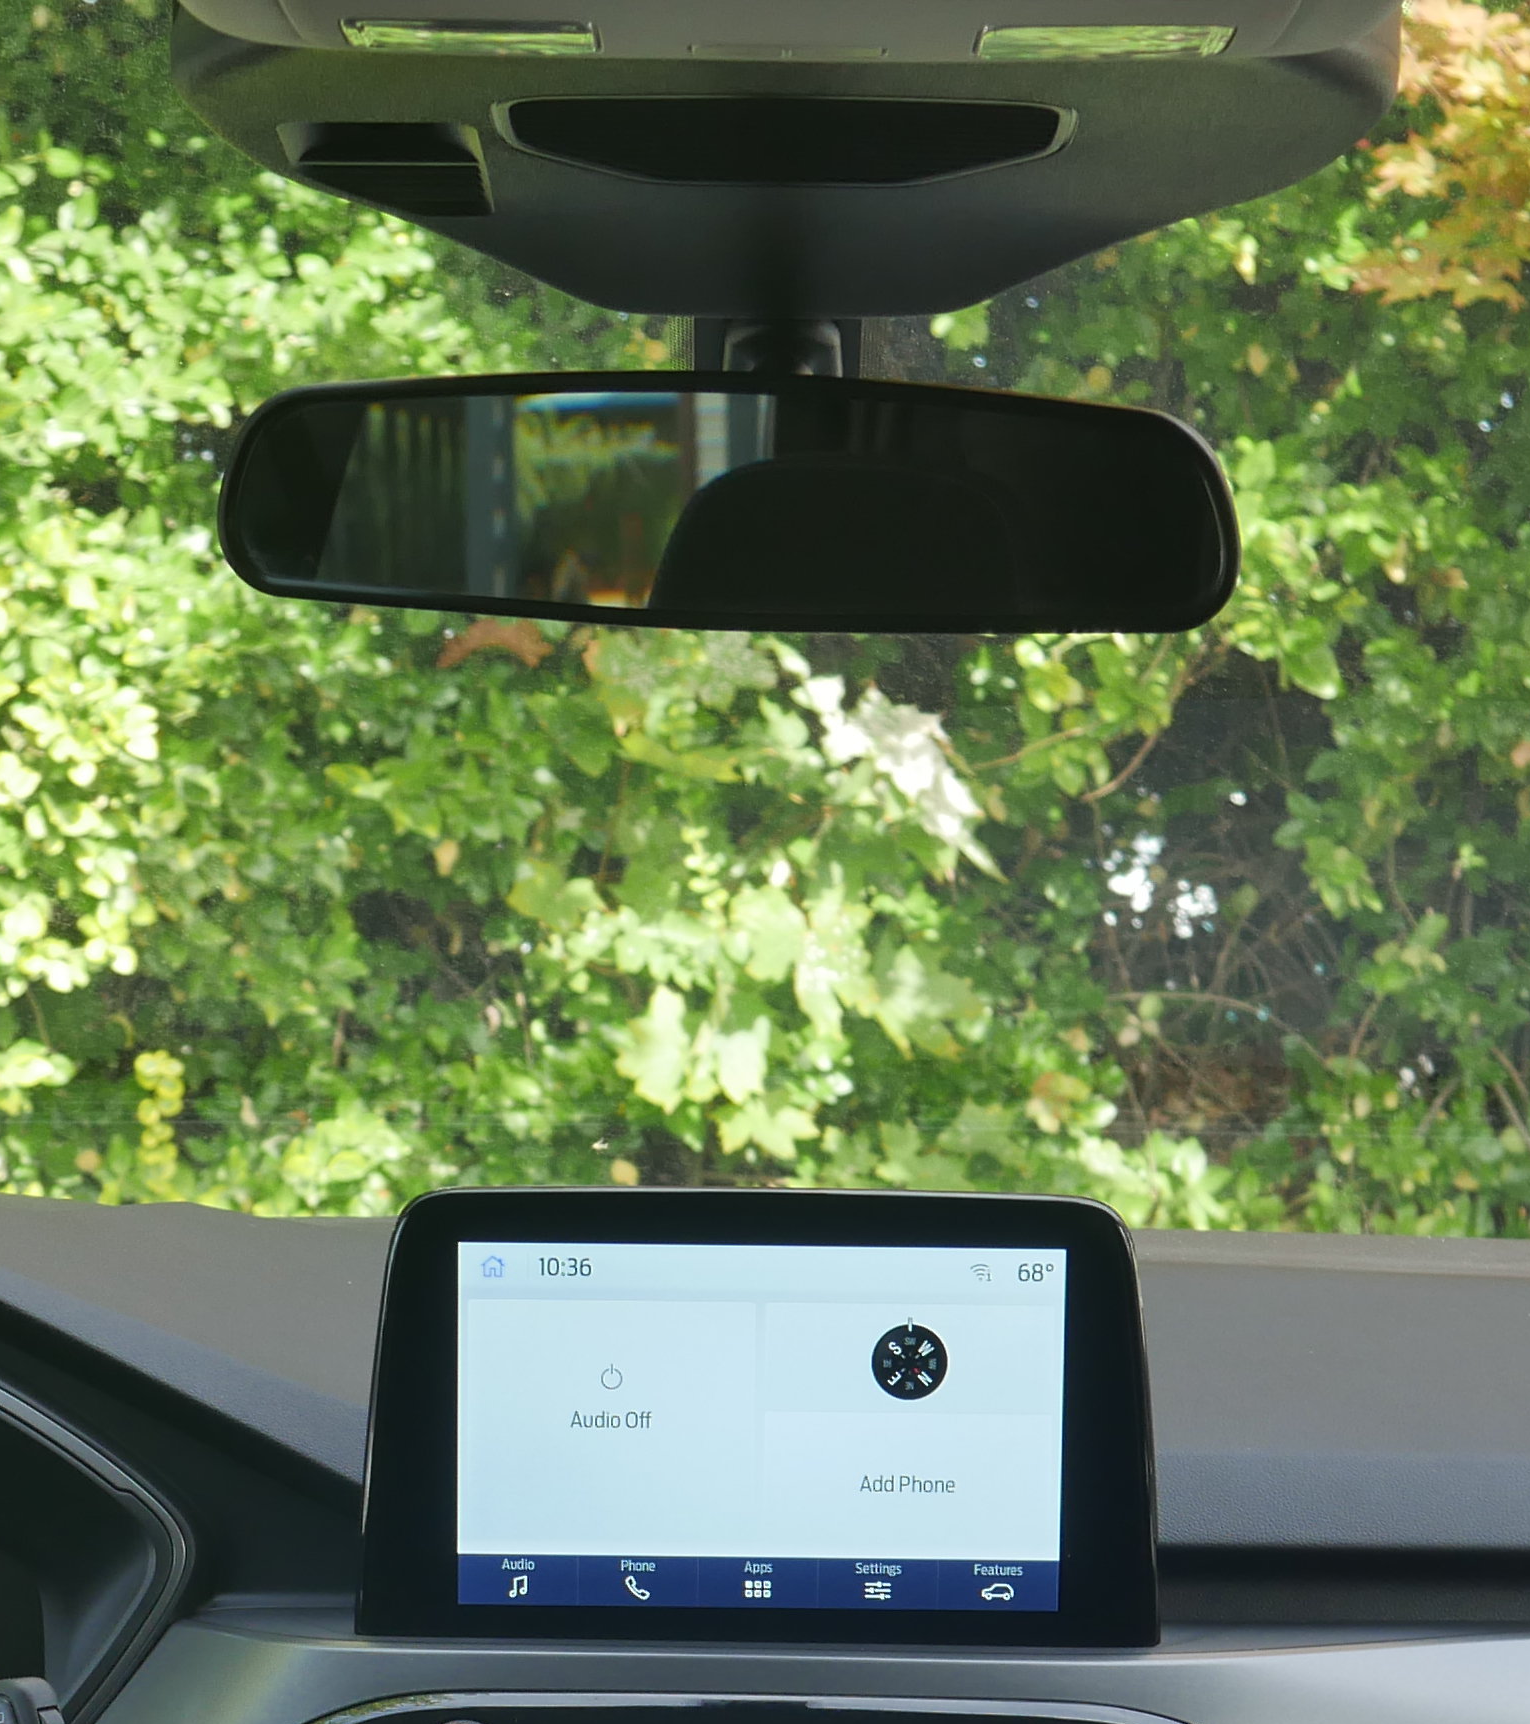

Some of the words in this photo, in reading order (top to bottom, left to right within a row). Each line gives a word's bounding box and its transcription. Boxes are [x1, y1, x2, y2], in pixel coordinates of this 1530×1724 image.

[538, 1257, 592, 1277] 10:36
[888, 1341, 902, 1356] S
[917, 1340, 935, 1357] W
[887, 1371, 902, 1386] E
[917, 1370, 933, 1387] N
[570, 1410, 621, 1429] Audio
[625, 1410, 652, 1429] Off
[860, 1475, 895, 1493] Add
[899, 1475, 956, 1493] Phone
[502, 1558, 535, 1571] Audio
[621, 1559, 656, 1572] Phone
[744, 1561, 773, 1575] Apps
[855, 1562, 902, 1576] Settings
[974, 1563, 1023, 1576] Features
